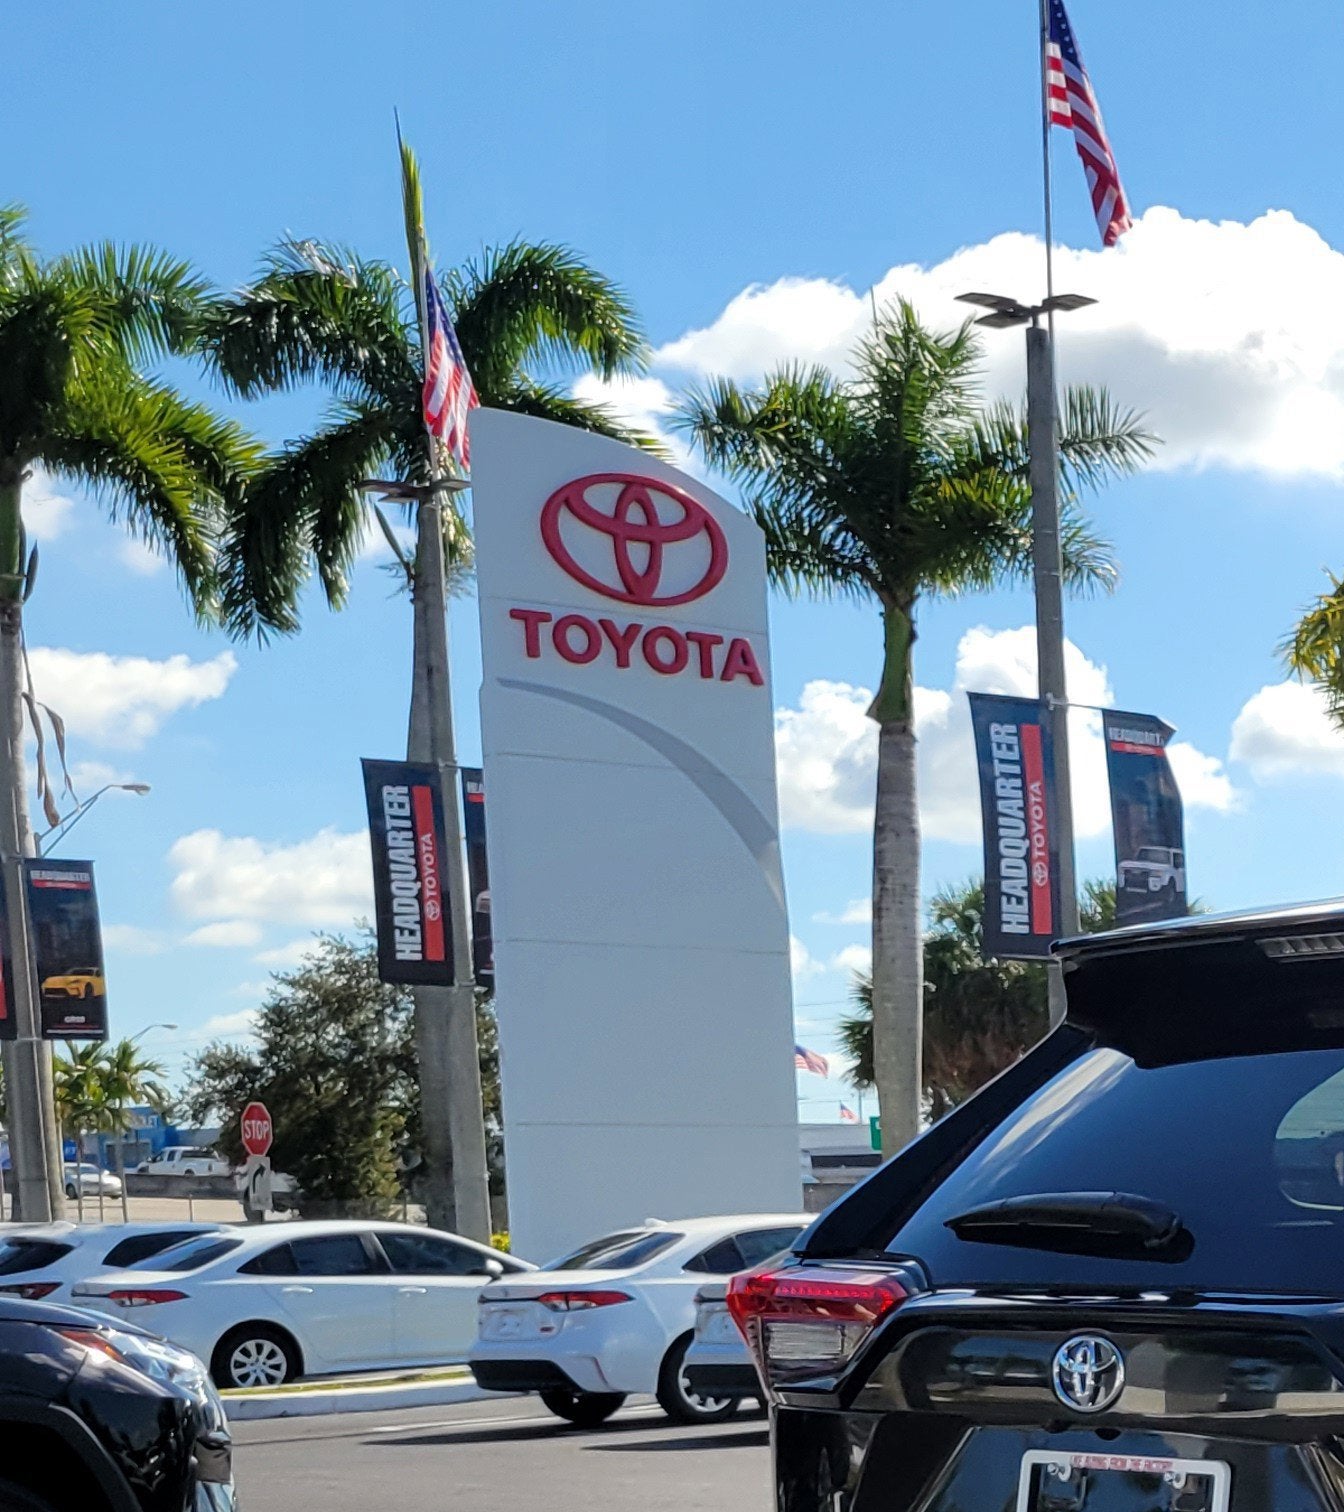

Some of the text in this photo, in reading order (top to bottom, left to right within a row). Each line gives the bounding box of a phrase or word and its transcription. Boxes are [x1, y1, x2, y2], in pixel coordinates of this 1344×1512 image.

[509, 608, 764, 686] TOYOTA
[989, 721, 1031, 935] HEADQUARTER
[1028, 781, 1048, 858] TOYOTA
[381, 784, 423, 962] HEADQUARTER
[420, 832, 438, 897] TOYOTA
[244, 1119, 270, 1140] STOP
